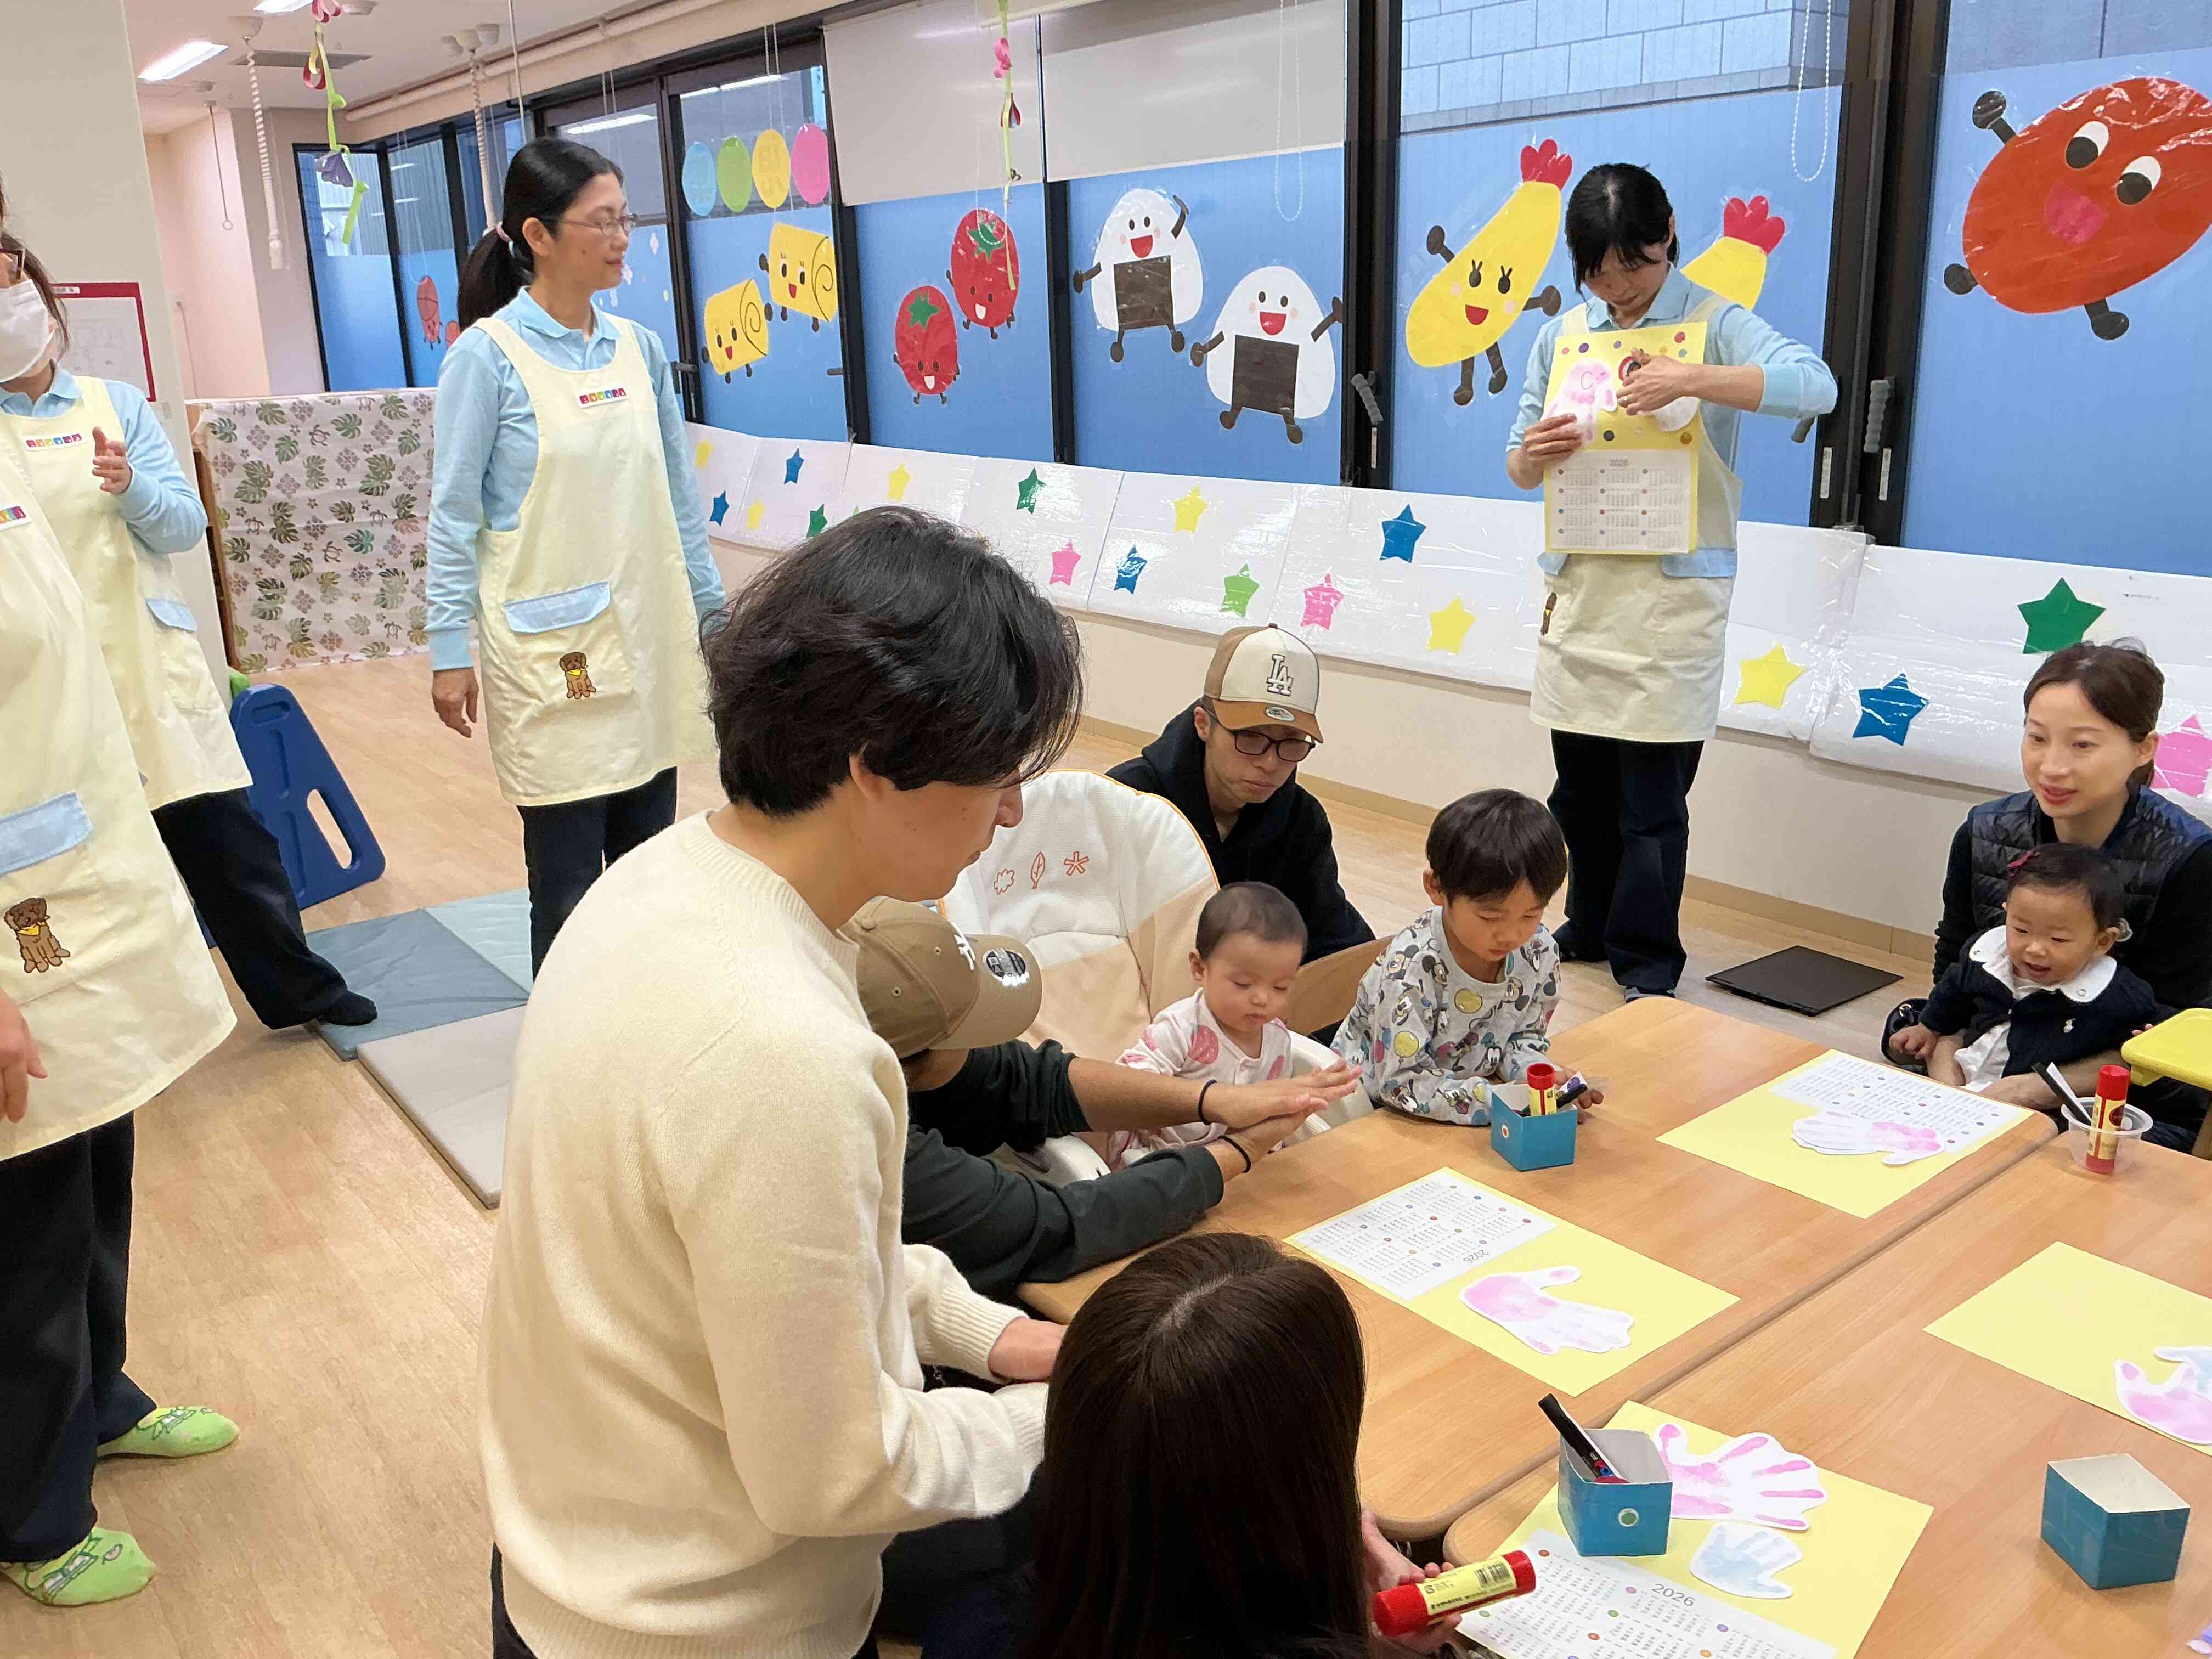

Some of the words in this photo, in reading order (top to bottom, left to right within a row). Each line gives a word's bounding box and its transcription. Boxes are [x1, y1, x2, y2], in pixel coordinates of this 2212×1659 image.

[1267, 654, 1293, 696] LA
[1463, 1249, 1489, 1263] 2026
[1651, 1583, 1696, 1606] 2026
